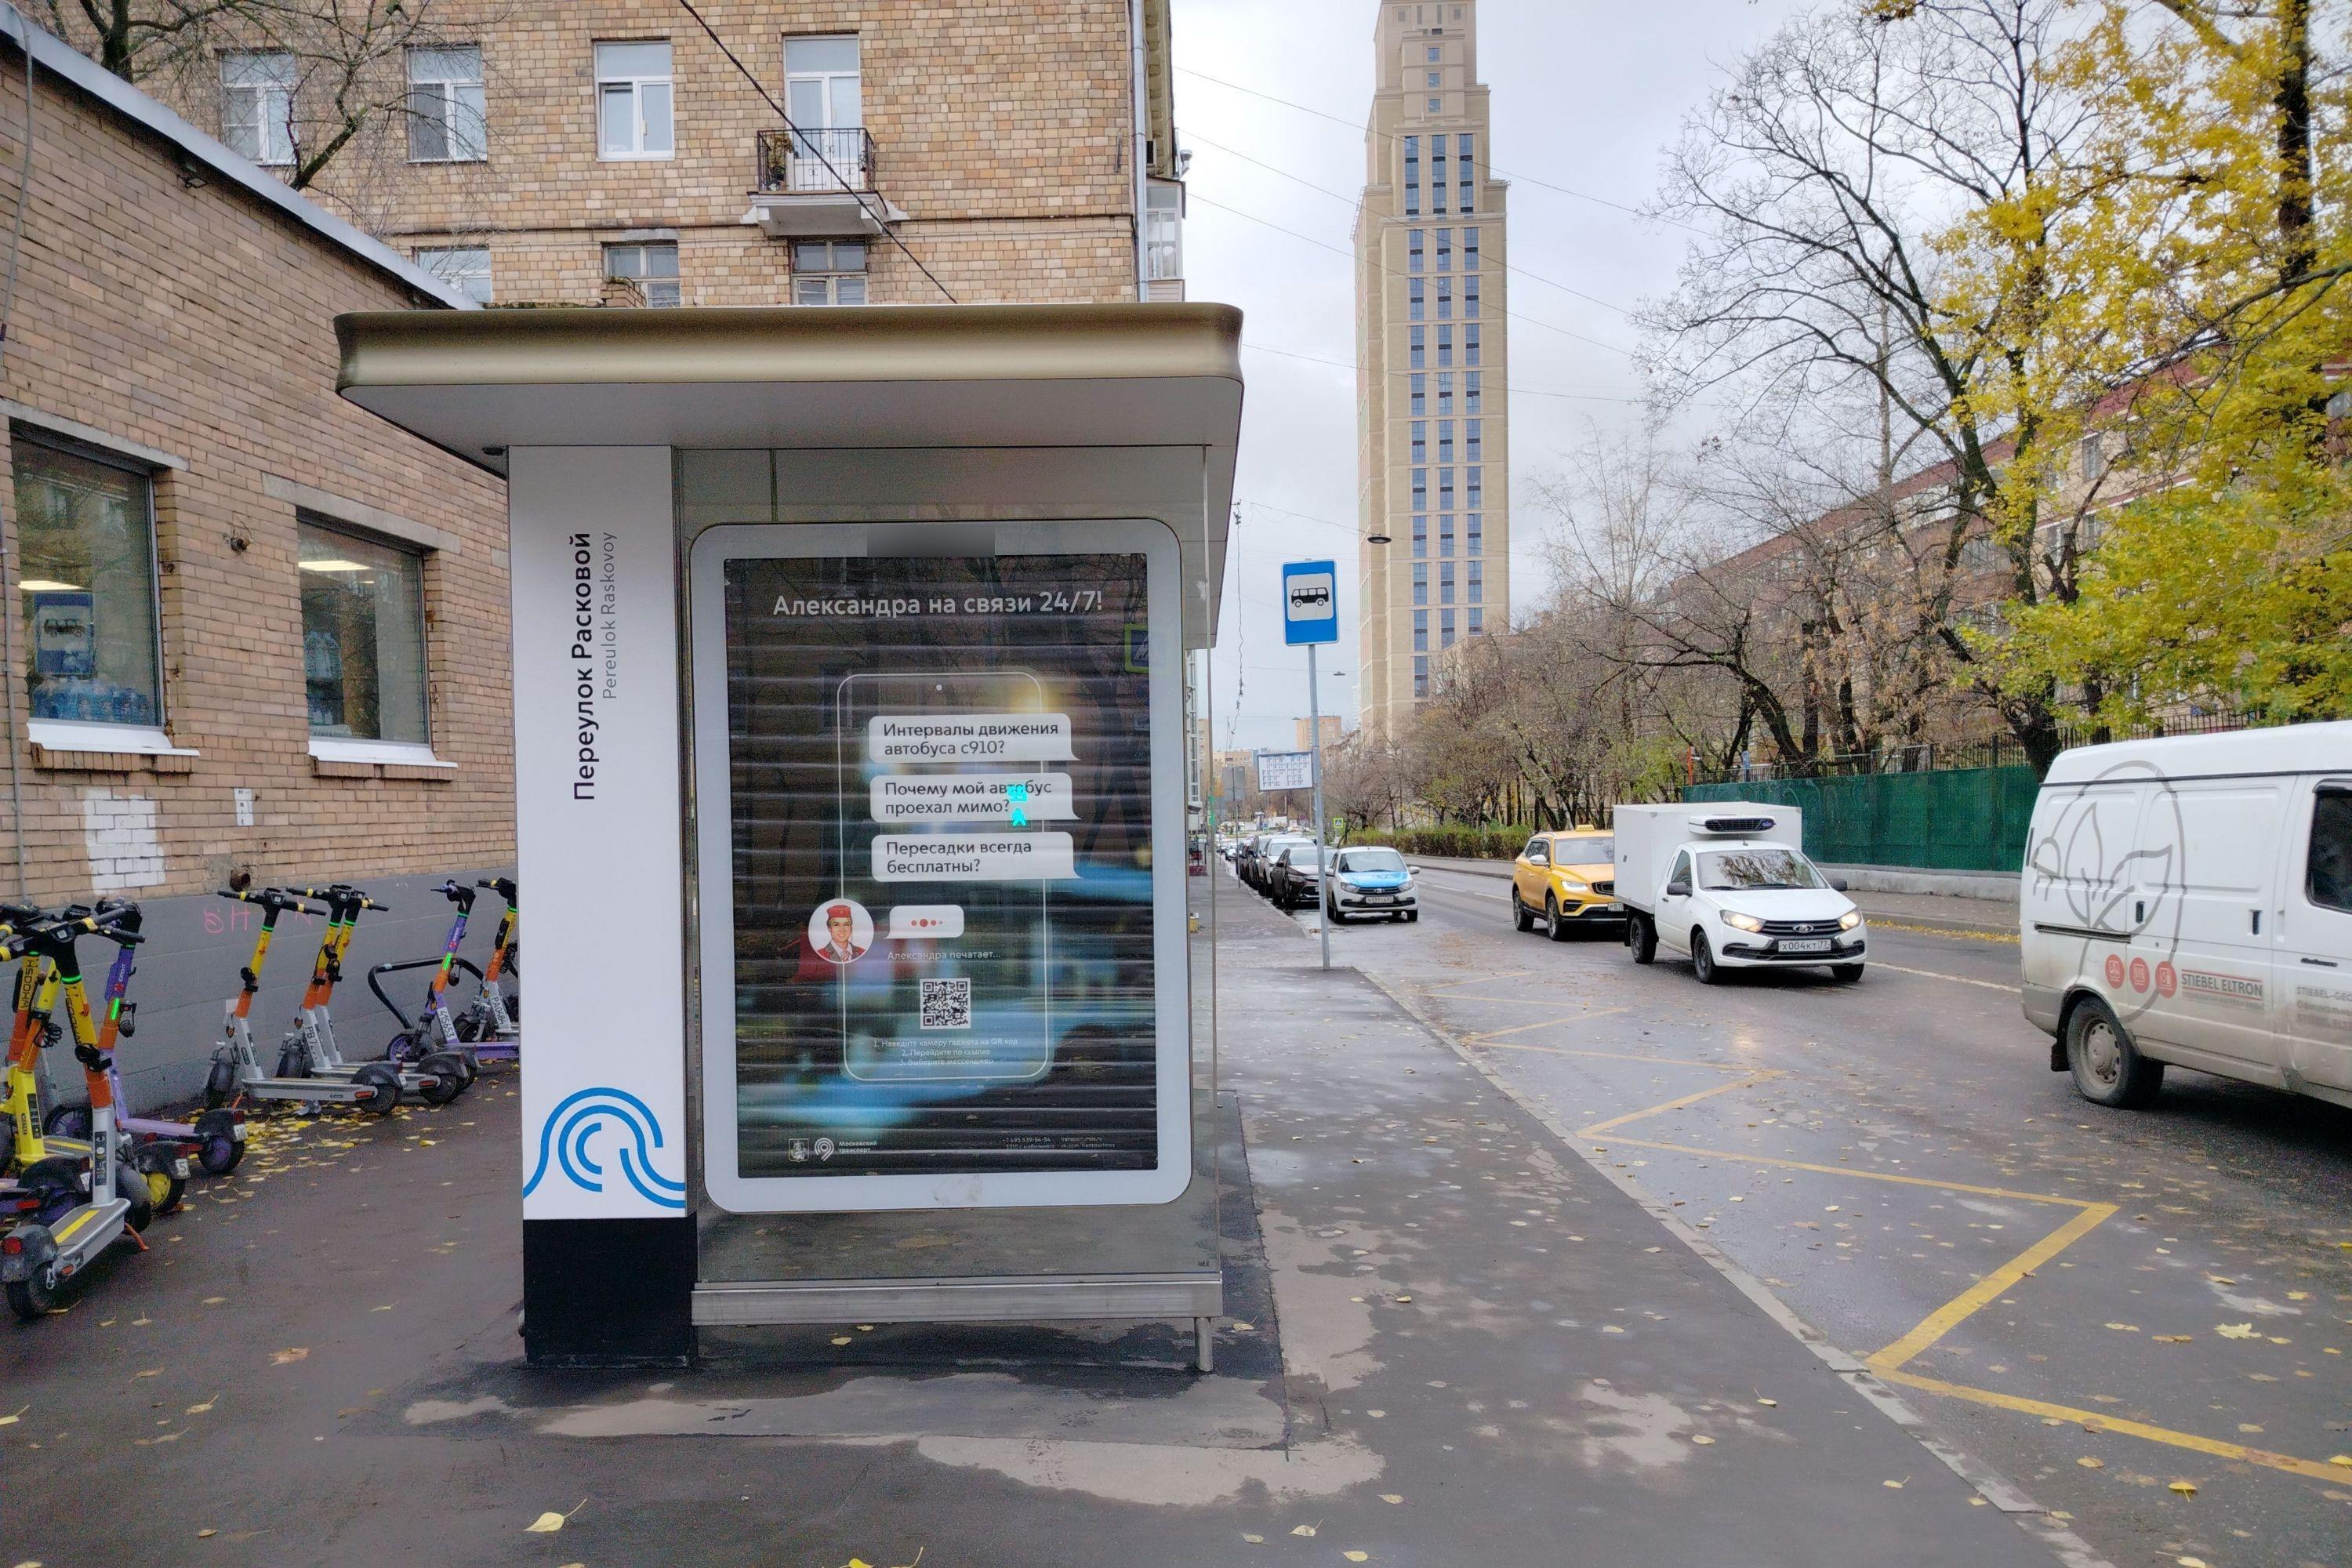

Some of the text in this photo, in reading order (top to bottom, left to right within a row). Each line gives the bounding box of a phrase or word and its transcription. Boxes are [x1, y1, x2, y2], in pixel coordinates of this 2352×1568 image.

[774, 591, 1102, 618] Александра на связи 24/7!
[600, 532, 617, 699] Pereulok Raskovoy
[569, 533, 600, 800] Переулок Расковой
[884, 724, 1058, 739] Интервалы движения
[884, 741, 1004, 757] автобуса с910?
[885, 782, 947, 797] Почему
[953, 782, 985, 794] мой
[886, 800, 1010, 817] проехал мимо?
[887, 841, 1032, 859] Пересадки всегда
[887, 859, 981, 873] бесплатны?
[887, 951, 946, 961] Александра
[2182, 973, 2263, 996] STIEBEL ELTRON
[919, 1040, 947, 1048] камеру
